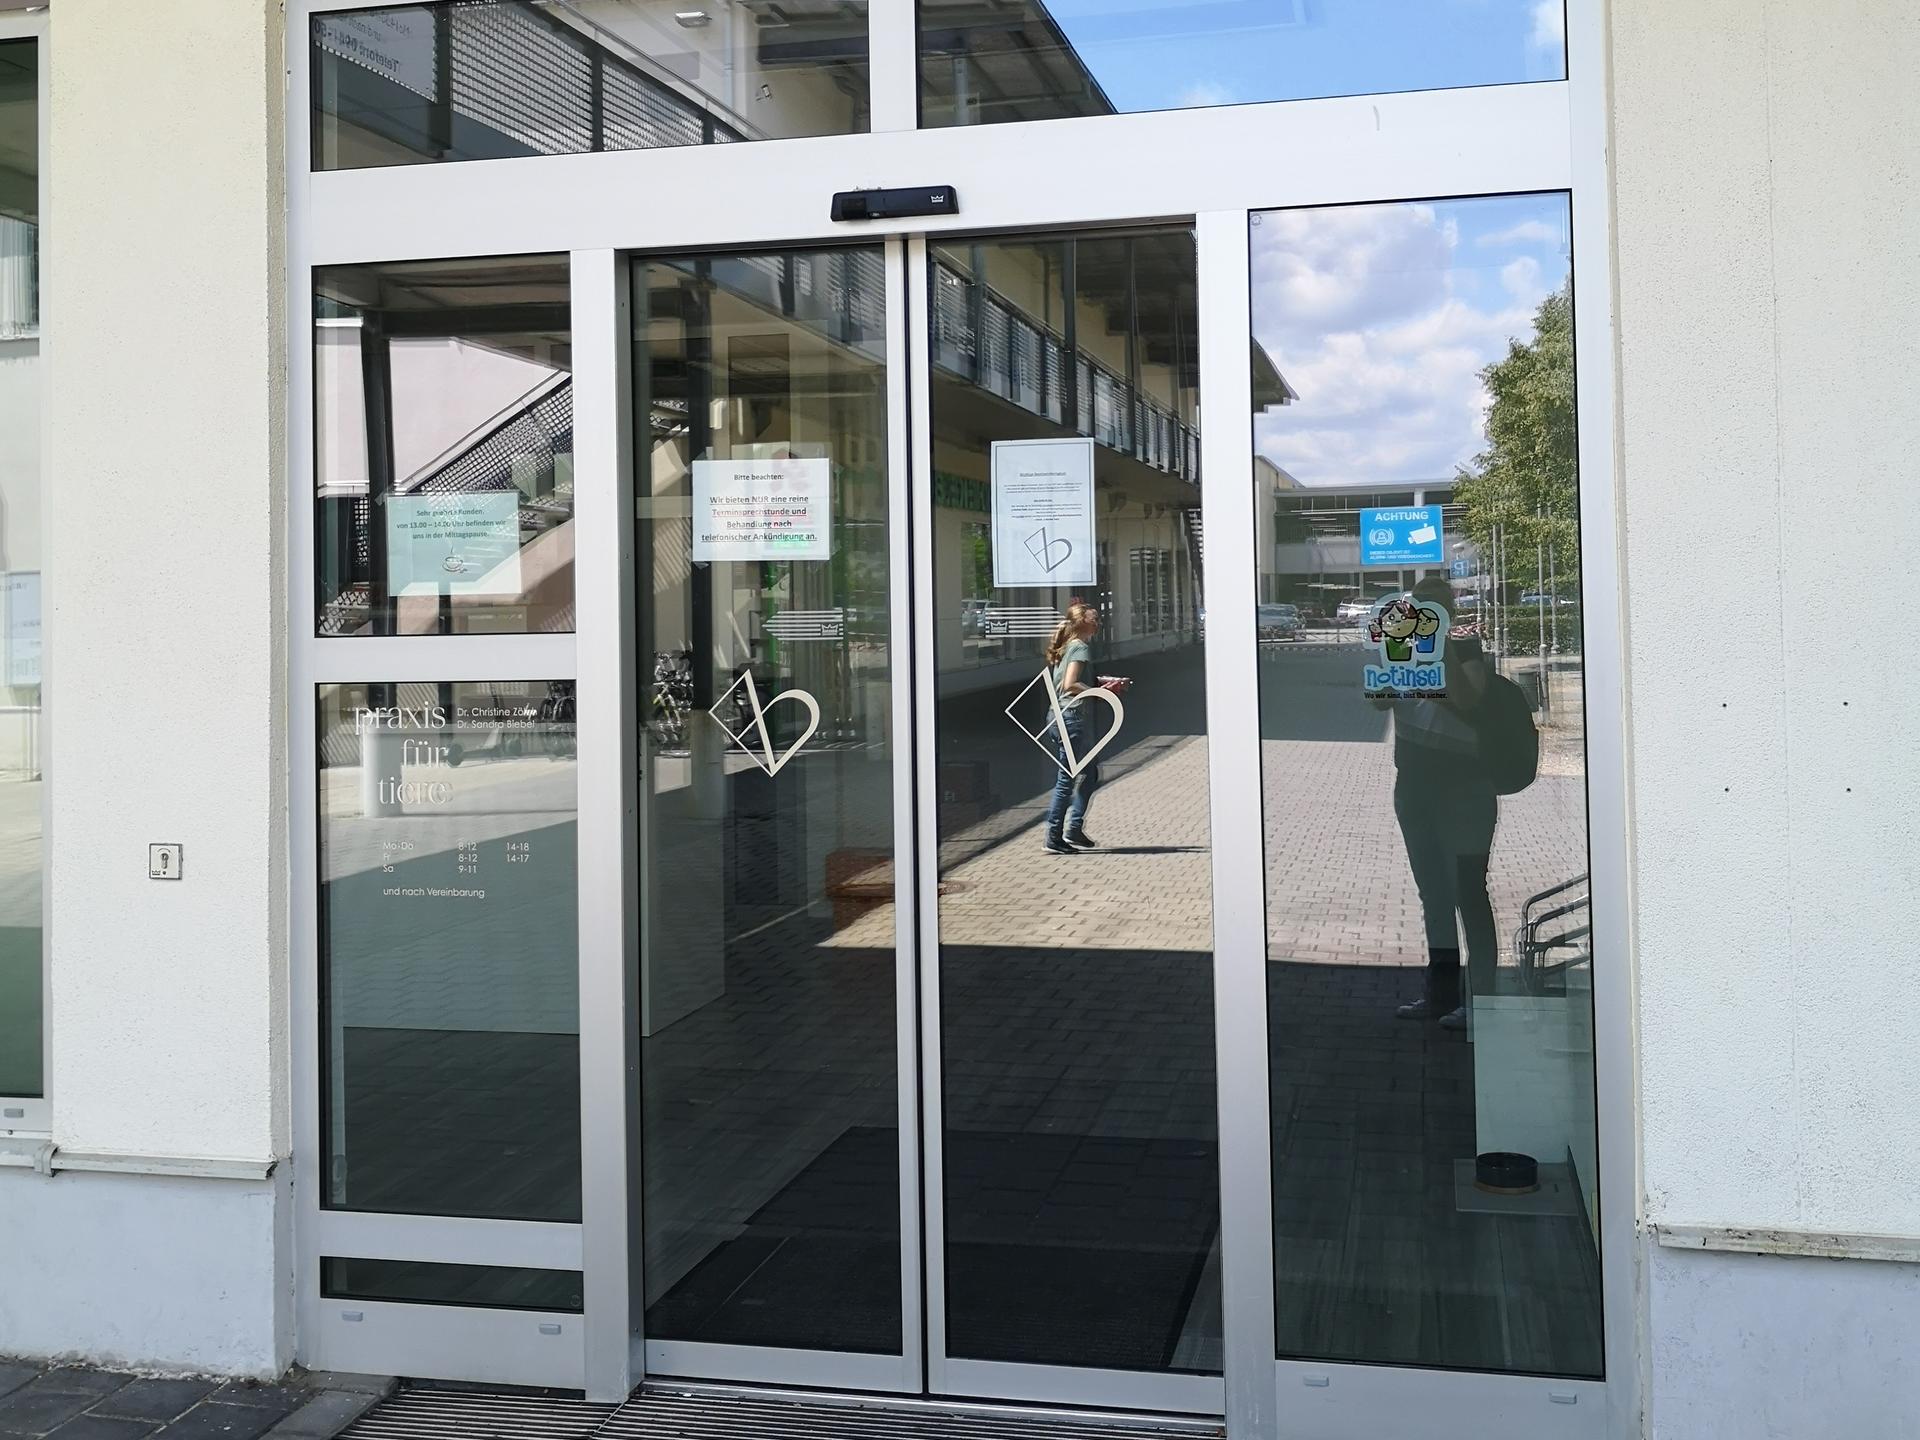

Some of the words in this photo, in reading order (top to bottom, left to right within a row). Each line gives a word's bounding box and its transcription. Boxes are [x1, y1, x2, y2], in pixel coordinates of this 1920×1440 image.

[734, 473, 750, 481] Bitte
[751, 473, 784, 481] beachten:
[709, 496, 724, 504] Wir
[725, 495, 750, 504] bieten
[751, 495, 769, 503] NUR
[788, 495, 809, 503] reine
[416, 509, 431, 517] Sehr
[791, 507, 807, 515] und
[1374, 511, 1429, 521] ACHTUNG
[410, 521, 428, 529] 13.00
[465, 519, 494, 527] befinden
[726, 520, 772, 529] Behandlung
[432, 531, 444, 539] der
[701, 533, 752, 541] telefonischer
[753, 532, 804, 541] Ankündigung
[805, 533, 818, 541] an.
[1366, 664, 1442, 688] notinsel
[457, 707, 469, 717] Dr.
[471, 707, 511, 717] Christine
[355, 701, 446, 736] praxis
[457, 720, 469, 729] Dr.
[471, 720, 504, 729] Sandra
[402, 738, 449, 768] für
[377, 776, 448, 805] tiere
[458, 842, 477, 850] 8-12
[506, 842, 530, 851] 14-18
[458, 854, 478, 863] 8-12
[506, 854, 530, 863] 14-17
[383, 864, 394, 873] Sa
[458, 865, 477, 873] 9-11
[383, 887, 400, 896] und
[402, 887, 425, 896] nach
[426, 887, 485, 899] Vereinbarung
